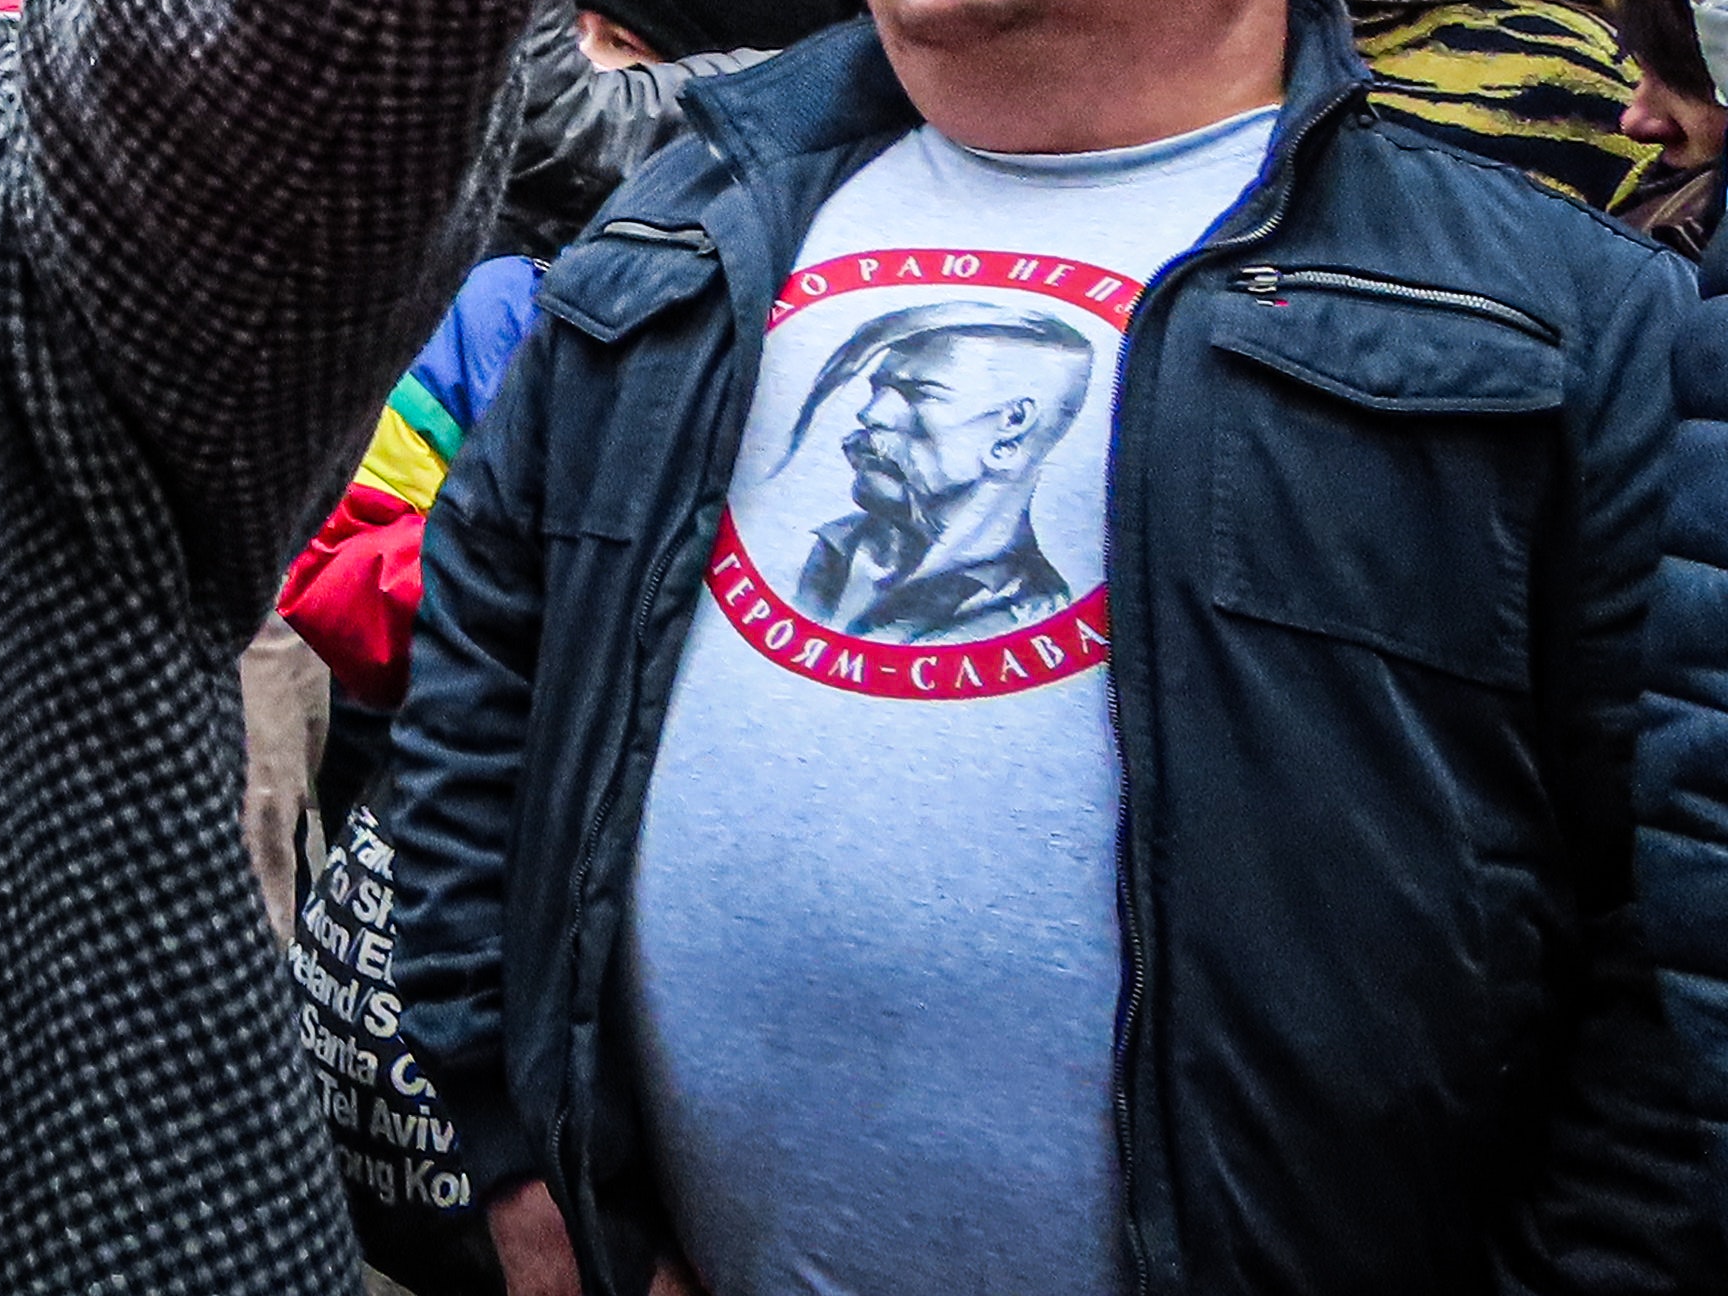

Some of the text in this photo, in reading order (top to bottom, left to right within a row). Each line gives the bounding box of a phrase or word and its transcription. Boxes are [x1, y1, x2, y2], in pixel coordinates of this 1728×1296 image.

[857, 254, 981, 282] РАЮ
[1007, 257, 1076, 287] НЕ
[300, 1004, 378, 1086] Santa
[317, 1069, 456, 1154] Tel Aviv
